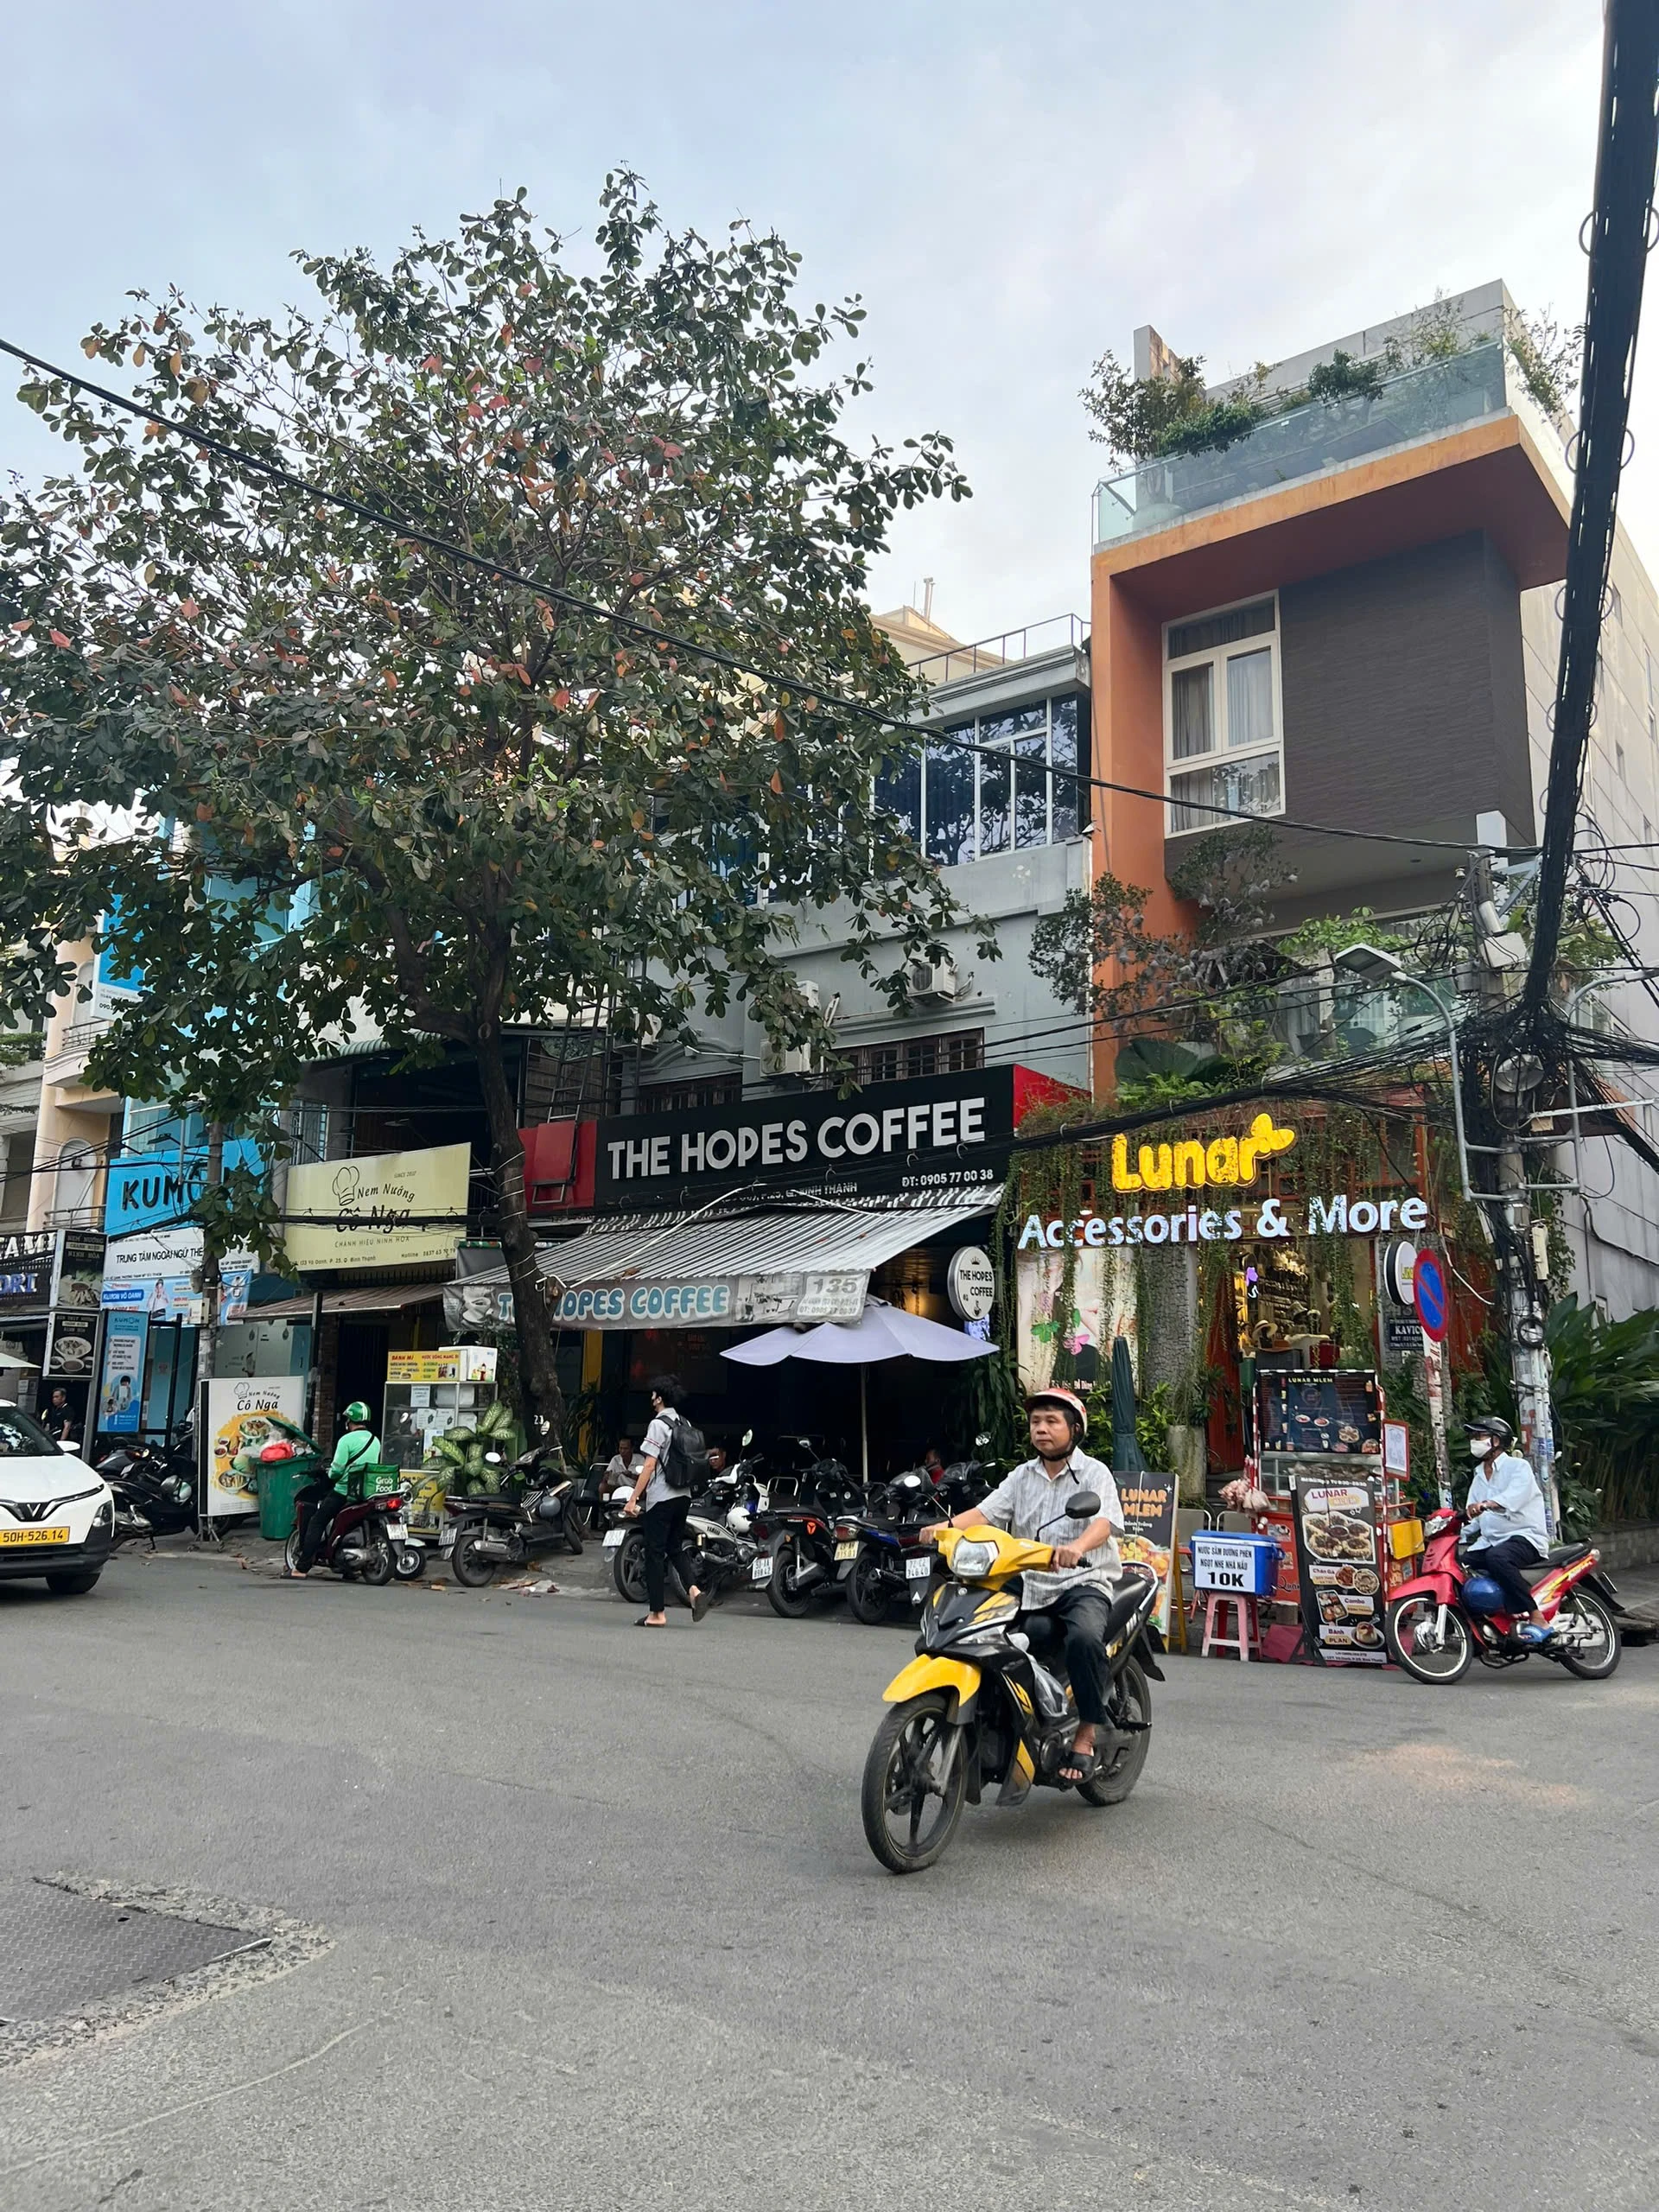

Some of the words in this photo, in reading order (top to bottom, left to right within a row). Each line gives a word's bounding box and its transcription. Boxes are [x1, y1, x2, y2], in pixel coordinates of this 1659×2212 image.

[607, 1135, 671, 1179] THE
[681, 1120, 808, 1173] HOPES
[817, 1096, 985, 1159] COFFEE
[1112, 1133, 1274, 1192] Lunar
[122, 1159, 229, 1211] KUMO
[902, 1176, 918, 1187] ĐT:
[920, 1172, 947, 1185] 0905
[949, 1171, 962, 1184] 77
[963, 1170, 978, 1181] 00
[980, 1169, 994, 1180] 38
[357, 1186, 378, 1199] Nem
[383, 1184, 416, 1203] Nướng
[823, 1181, 858, 1196] THẠNH
[336, 1207, 360, 1232] Cô
[369, 1205, 411, 1233] Nga
[1017, 1205, 1242, 1249] Accessories
[1257, 1198, 1290, 1238] &
[1308, 1195, 1427, 1236] More
[377, 1236, 393, 1244] NINH
[116, 1253, 137, 1264] TRUNG
[138, 1250, 152, 1262] TÂM
[960, 1270, 970, 1281] THE
[971, 1270, 993, 1282] HOPES
[813, 1278, 859, 1294] 135
[970, 1287, 993, 1298] COFFEE
[630, 1285, 730, 1320] COFFEE
[114, 1316, 140, 1325] KUMON
[237, 1400, 251, 1411] Cô
[255, 1399, 278, 1412] Nga
[375, 1476, 393, 1484] Grab
[1121, 1488, 1167, 1503] LUNAR
[1311, 1489, 1348, 1499] LUNAR
[1123, 1503, 1163, 1517] MLEM
[3, 1529, 64, 1543] 50H-526.14
[1198, 1546, 1211, 1555] NƯỚC
[1200, 1558, 1213, 1569] NGỌT
[1214, 1559, 1224, 1570] NHẸ
[1207, 1571, 1244, 1587] 10K
